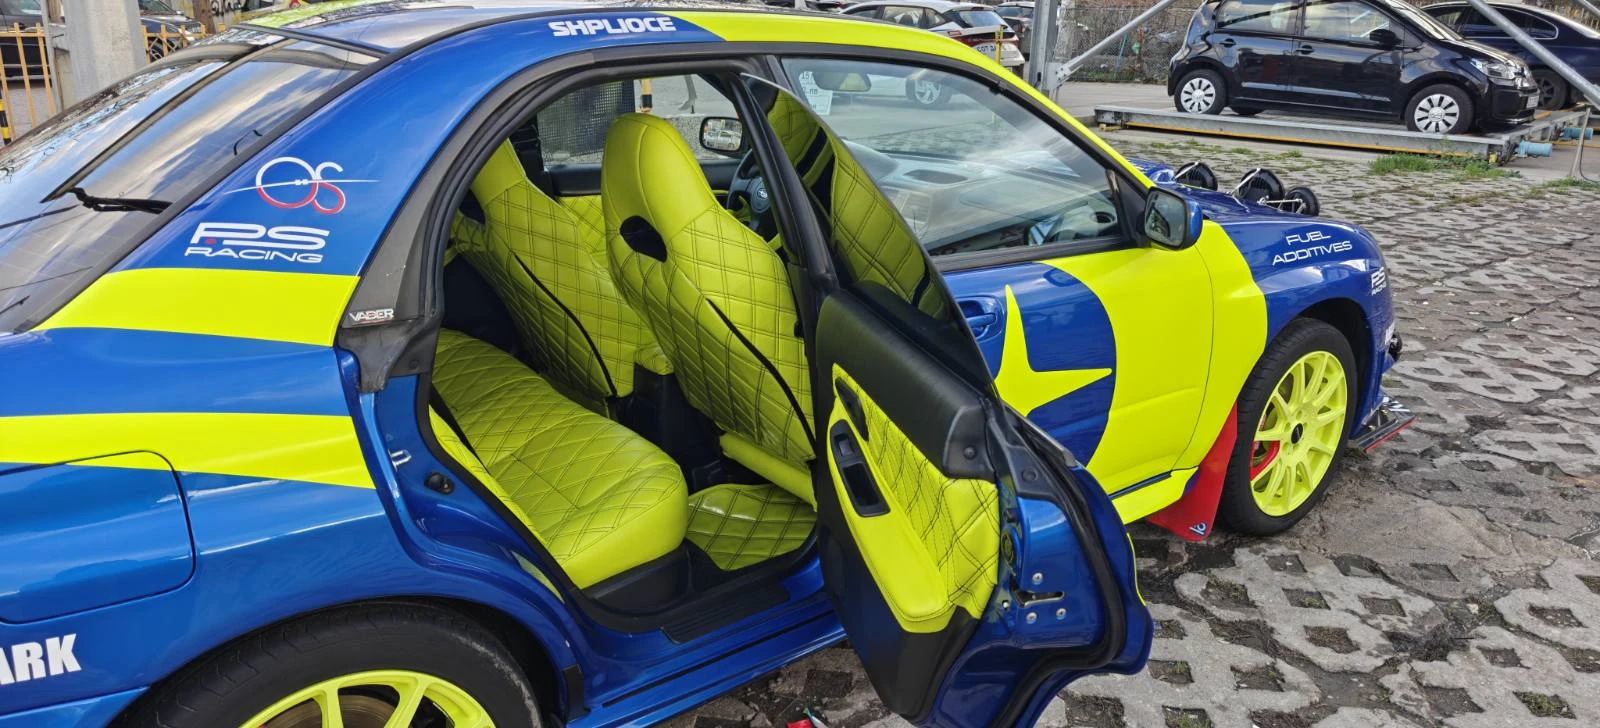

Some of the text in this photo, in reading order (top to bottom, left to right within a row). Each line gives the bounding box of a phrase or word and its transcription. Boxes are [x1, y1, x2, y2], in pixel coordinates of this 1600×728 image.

[1286, 230, 1331, 245] FUEL
[184, 246, 323, 264] RACING
[1272, 241, 1353, 266] ADDITIVES
